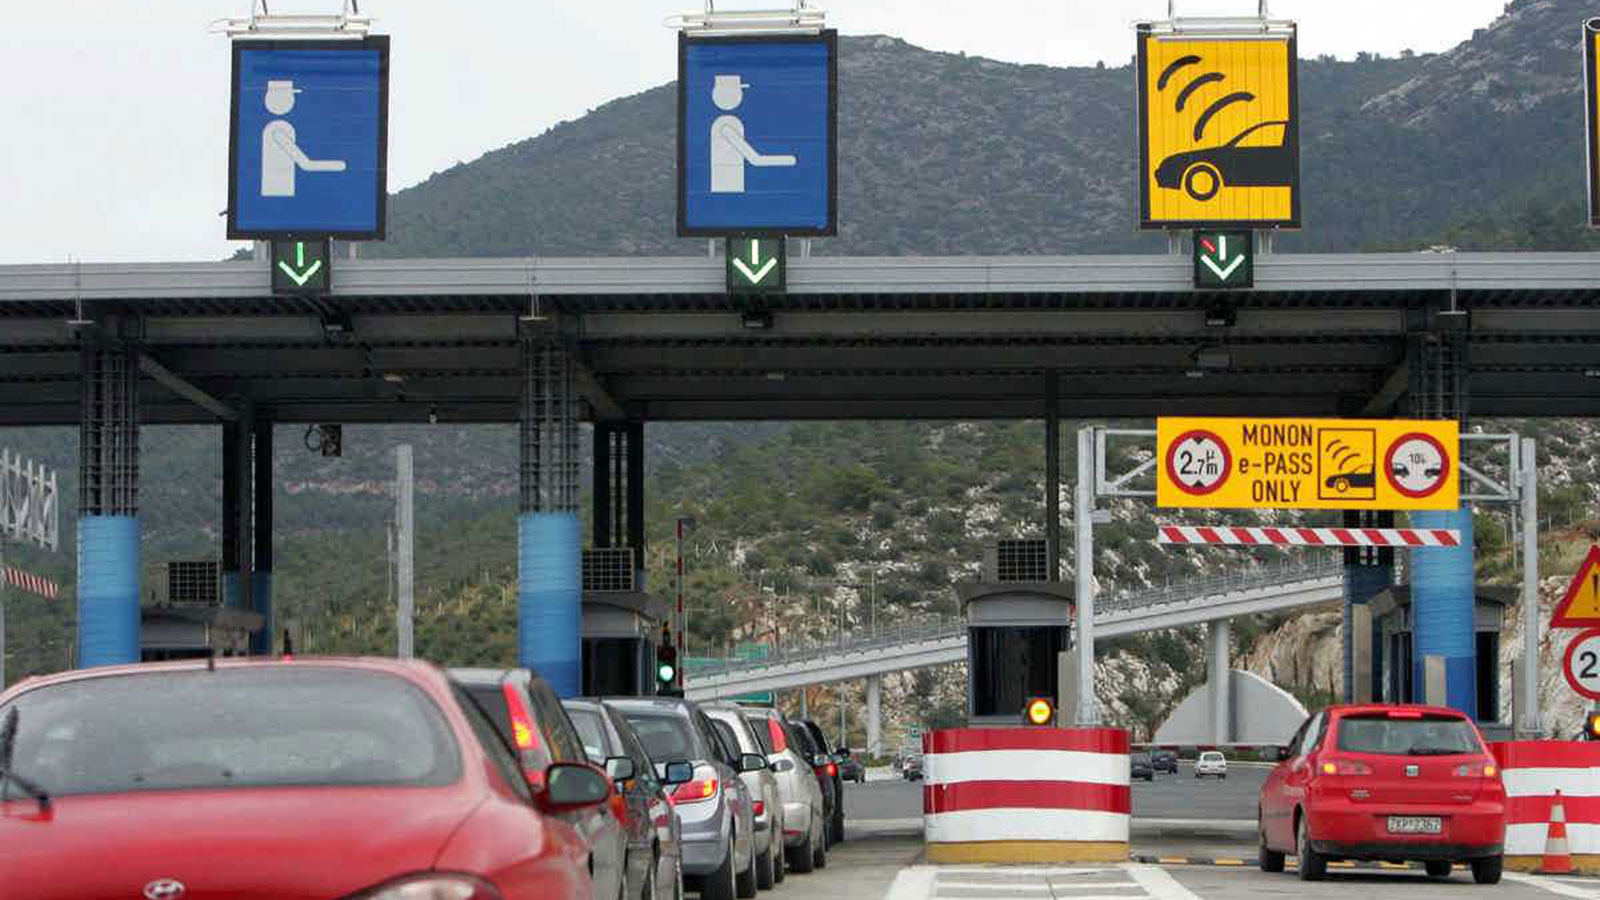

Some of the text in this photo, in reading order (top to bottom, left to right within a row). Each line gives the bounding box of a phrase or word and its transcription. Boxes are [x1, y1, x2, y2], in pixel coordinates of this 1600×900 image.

[1242, 424, 1313, 447] MONON
[1239, 452, 1313, 475] e-PASS
[1252, 479, 1301, 503] ONLY
